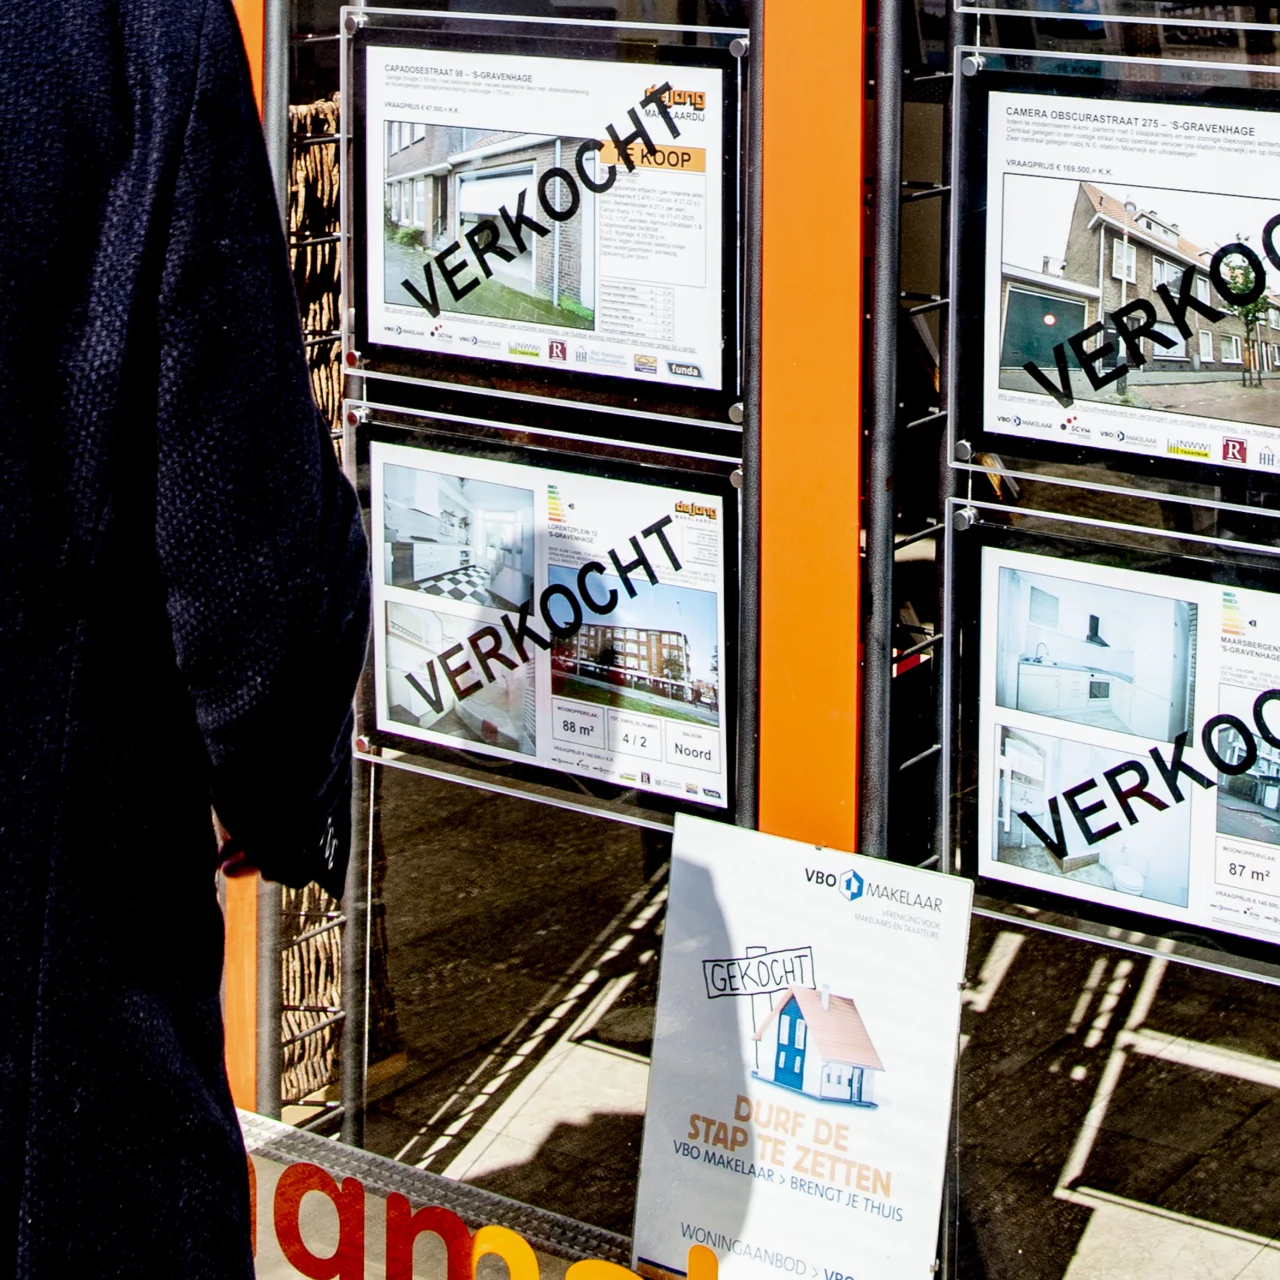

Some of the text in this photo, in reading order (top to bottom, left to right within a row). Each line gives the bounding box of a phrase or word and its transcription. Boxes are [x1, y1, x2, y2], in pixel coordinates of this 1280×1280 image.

[385, 64, 533, 83] CAPADOSESTRAAT 98 'S-GRAVENHAGE
[385, 102, 420, 111] VRAAGPRIJS
[1006, 106, 1158, 128] CAMERA OBSCURASTRAAT 275
[1170, 121, 1255, 136] 'S-GRAVENHAGE
[641, 149, 691, 168] KOOP
[1006, 159, 1054, 170] VRAAGPRIJS
[401, 81, 681, 318] VERKOCHT
[671, 363, 698, 377] funda
[548, 524, 590, 535] LORENTZPLEIN
[405, 515, 683, 715] VERKOCHT
[1221, 646, 1280, 662] 'S-GRAVENHAGE
[562, 720, 576, 733] 88
[623, 734, 647, 748] 4 2
[674, 743, 712, 761] Noord
[1228, 862, 1246, 877] 87
[805, 868, 942, 912] VBO MAKELAAR
[855, 913, 939, 940] MAKELAARS EN TAXATEURS
[882, 910, 940, 929] VERENIGING VOOR
[710, 954, 809, 992] GEKOCHT
[734, 1094, 850, 1152] DURF DE
[688, 1113, 892, 1198] STAP TE ZETTEN
[673, 1139, 903, 1222] VBO MAKELAAR BRENGT JE THUIS
[681, 1222, 806, 1275] WONINGAANBOD
